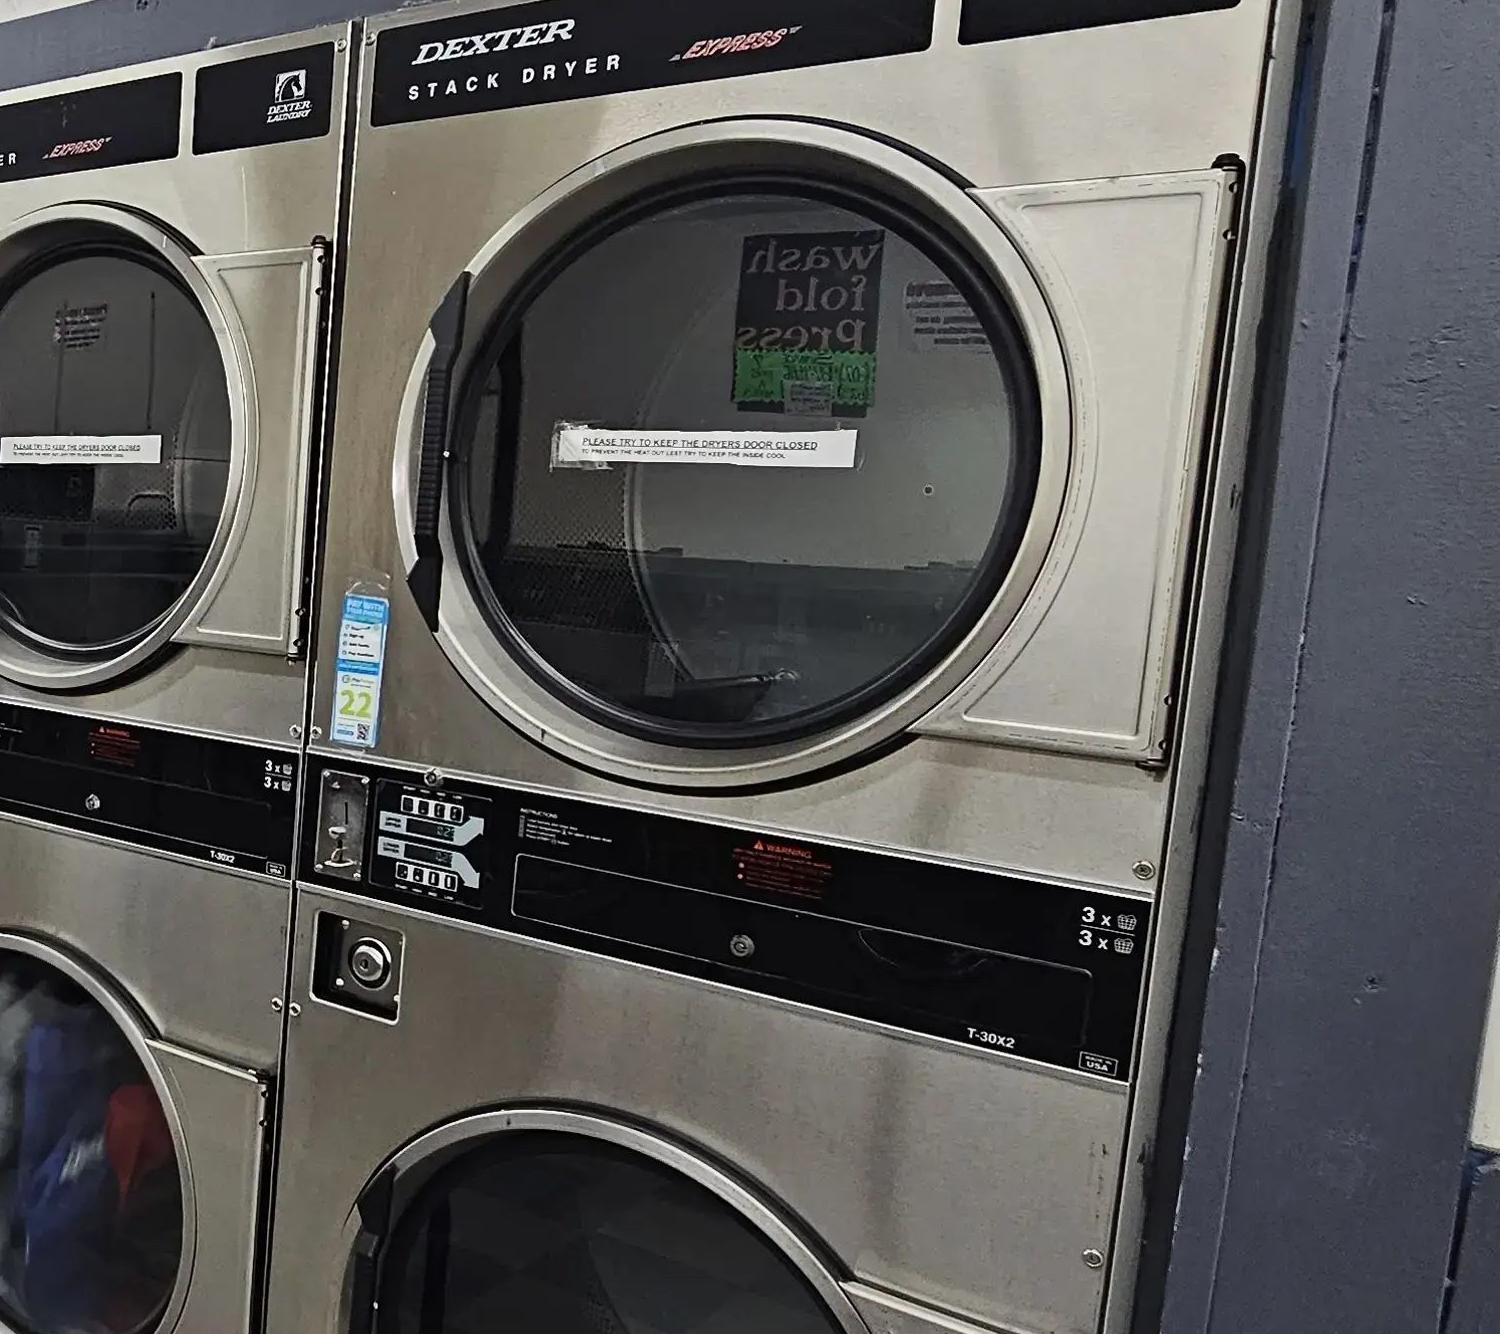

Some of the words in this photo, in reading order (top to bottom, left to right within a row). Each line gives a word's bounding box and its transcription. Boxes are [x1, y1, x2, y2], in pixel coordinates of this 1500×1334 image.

[411, 18, 576, 65] DEXTER
[679, 27, 790, 60] EXPRESS
[408, 71, 501, 101] STACK
[521, 53, 621, 84] DRYER
[267, 100, 311, 115] DEXTER
[47, 137, 106, 158] EXPRESS
[582, 438, 617, 446] PLEASE
[619, 439, 637, 447] TRY
[639, 439, 651, 447] TO
[653, 439, 678, 447] KEEP
[681, 440, 699, 448] THE
[701, 440, 740, 448] DRYERS
[743, 441, 773, 449] DOOR
[775, 441, 818, 450] CLOSED
[339, 689, 373, 718] 22
[264, 759, 273, 772] 3
[274, 765, 281, 773] x
[263, 776, 271, 788] 3
[273, 781, 279, 790] x
[766, 843, 812, 859] WARNING
[1081, 906, 1096, 923] 3
[1100, 914, 1112, 927] x
[1078, 929, 1093, 946] 3
[1097, 937, 1108, 950] x
[967, 1027, 1016, 1050] T-30X2
[1086, 1061, 1109, 1072] USA
